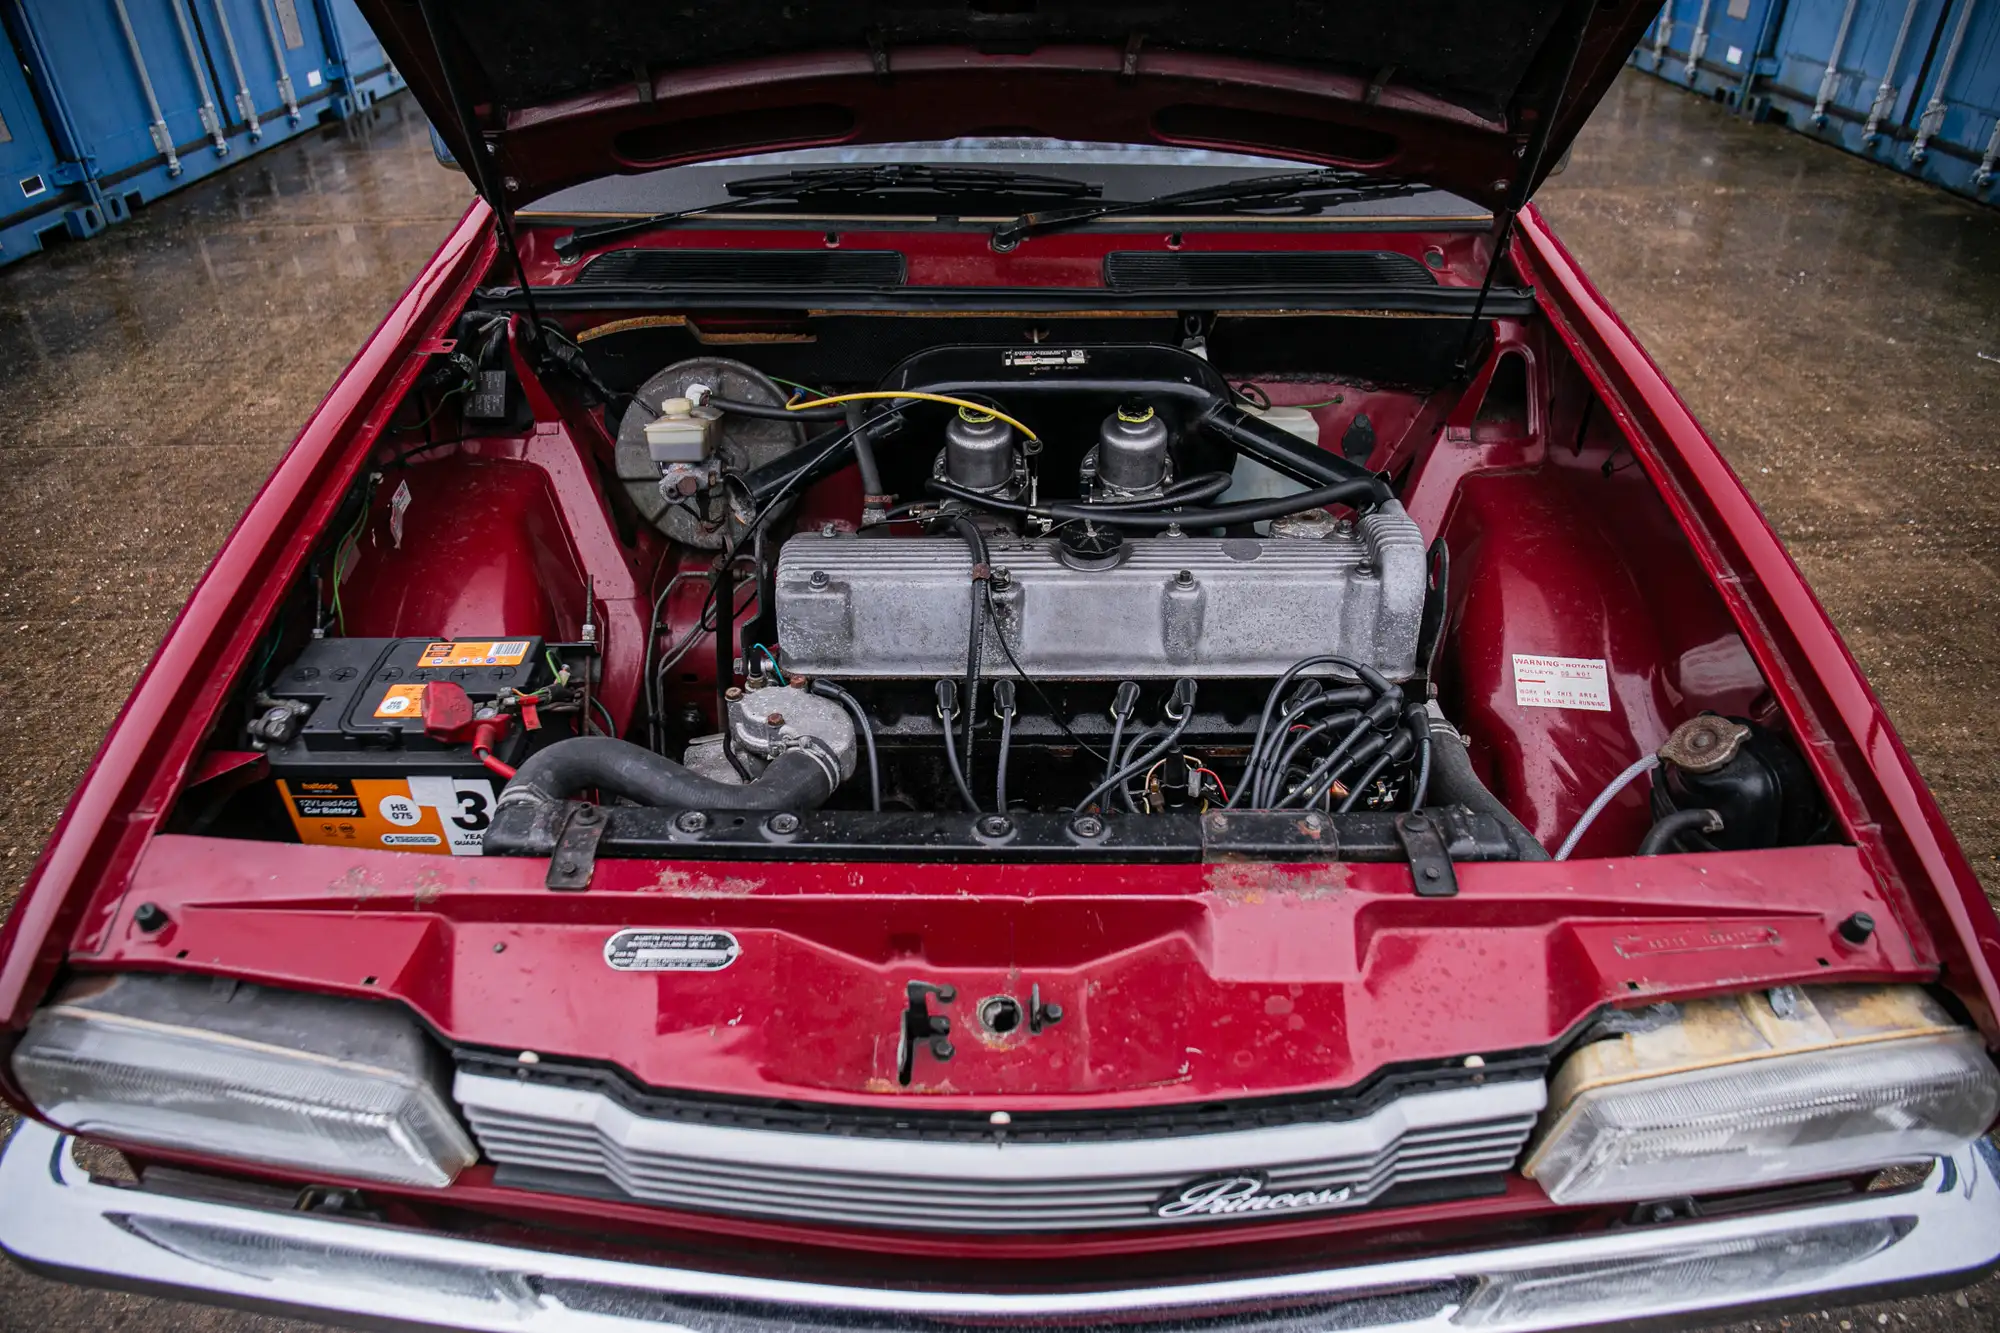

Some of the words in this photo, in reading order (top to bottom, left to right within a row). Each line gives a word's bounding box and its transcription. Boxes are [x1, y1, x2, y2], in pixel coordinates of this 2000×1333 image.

[1514, 658, 1560, 668] WARNING
[300, 799, 316, 807] 12V
[317, 799, 338, 807] Lead
[338, 799, 358, 807] Acid
[304, 806, 321, 814] Car
[322, 806, 358, 815] Battery
[391, 804, 408, 812] HB
[451, 789, 491, 831] 3
[392, 812, 413, 820] 075
[1158, 1176, 1350, 1218] Princess
